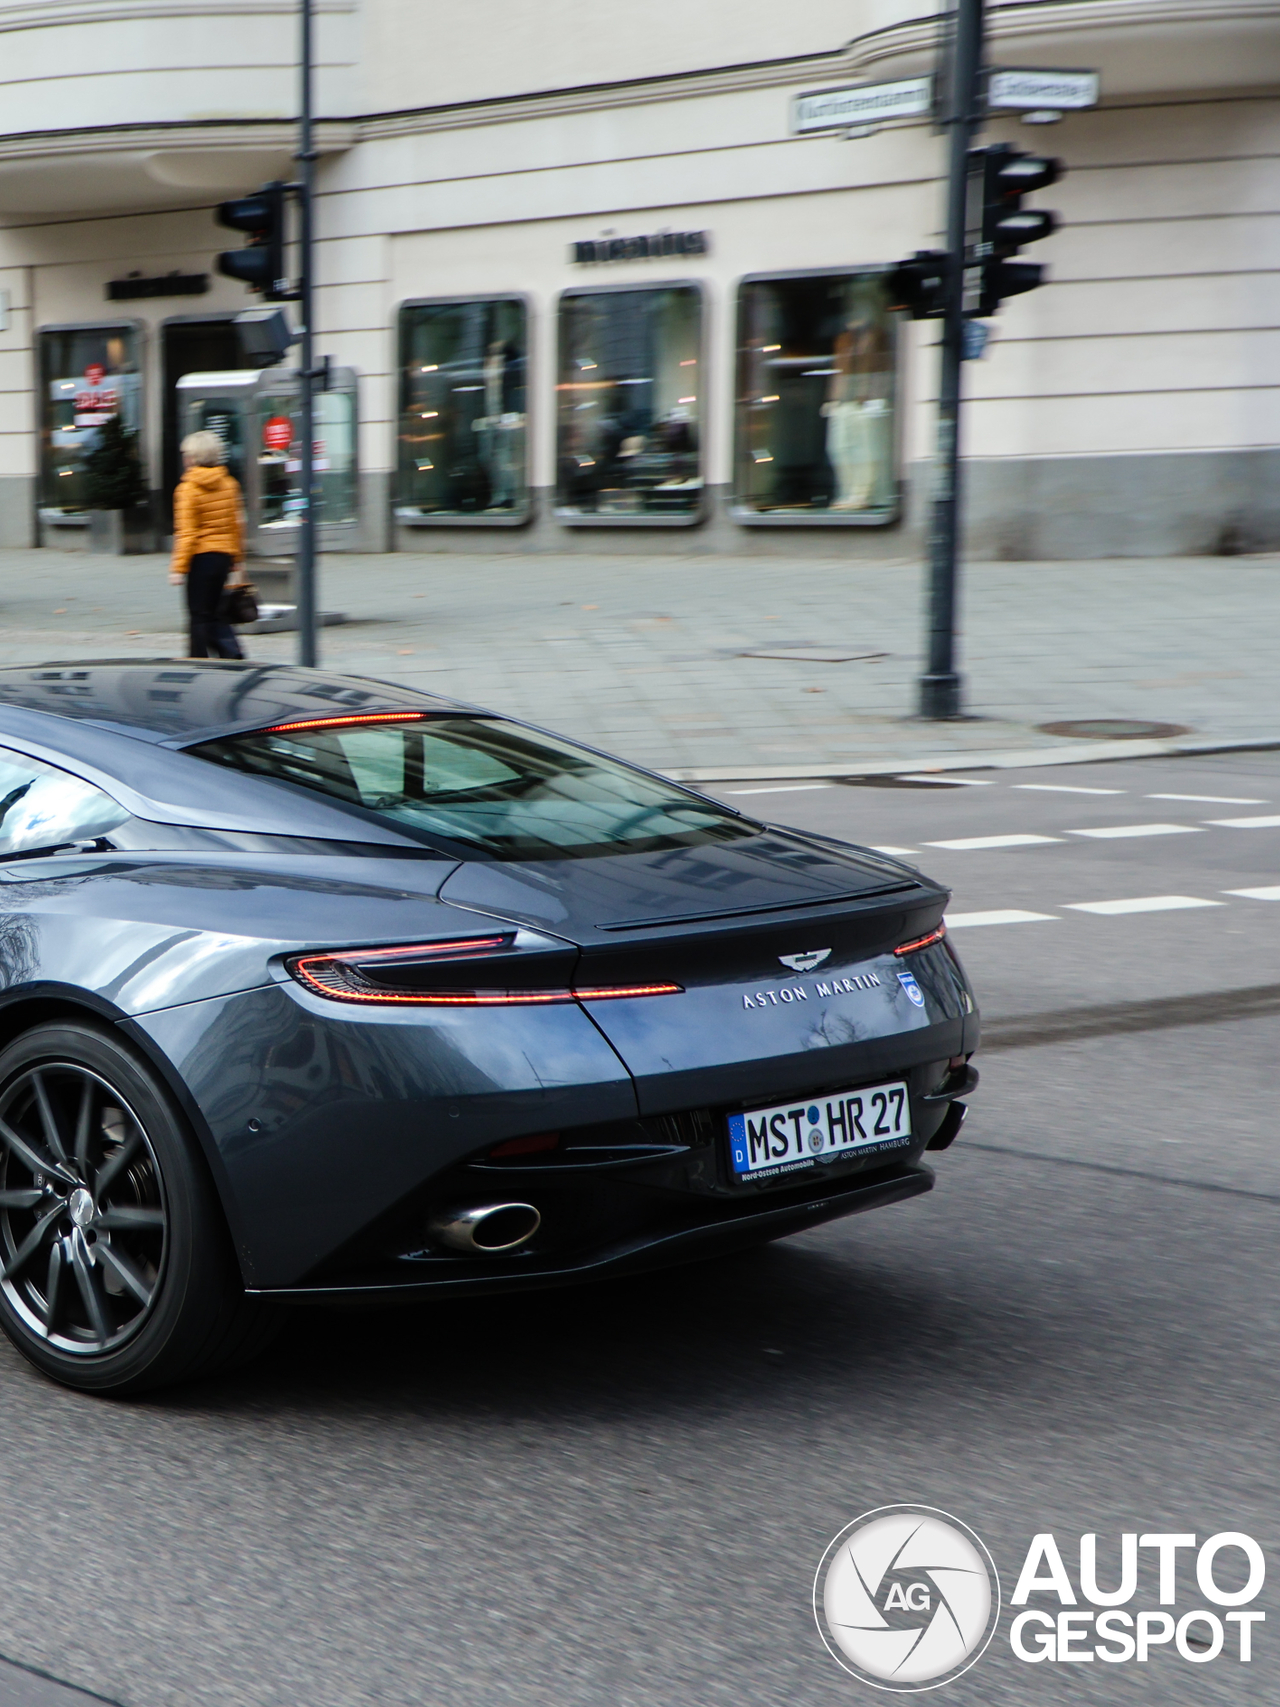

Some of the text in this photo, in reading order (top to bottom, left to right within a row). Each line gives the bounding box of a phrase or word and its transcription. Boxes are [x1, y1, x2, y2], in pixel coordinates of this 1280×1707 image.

[742, 972, 881, 1010] ASTON MARTIN
[747, 1087, 905, 1163] MST HR 27
[735, 1149, 744, 1163] D
[841, 1137, 910, 1160] ASTON MARTIN HAMBURG
[741, 1159, 815, 1181] Nord-Ostsee Automobile
